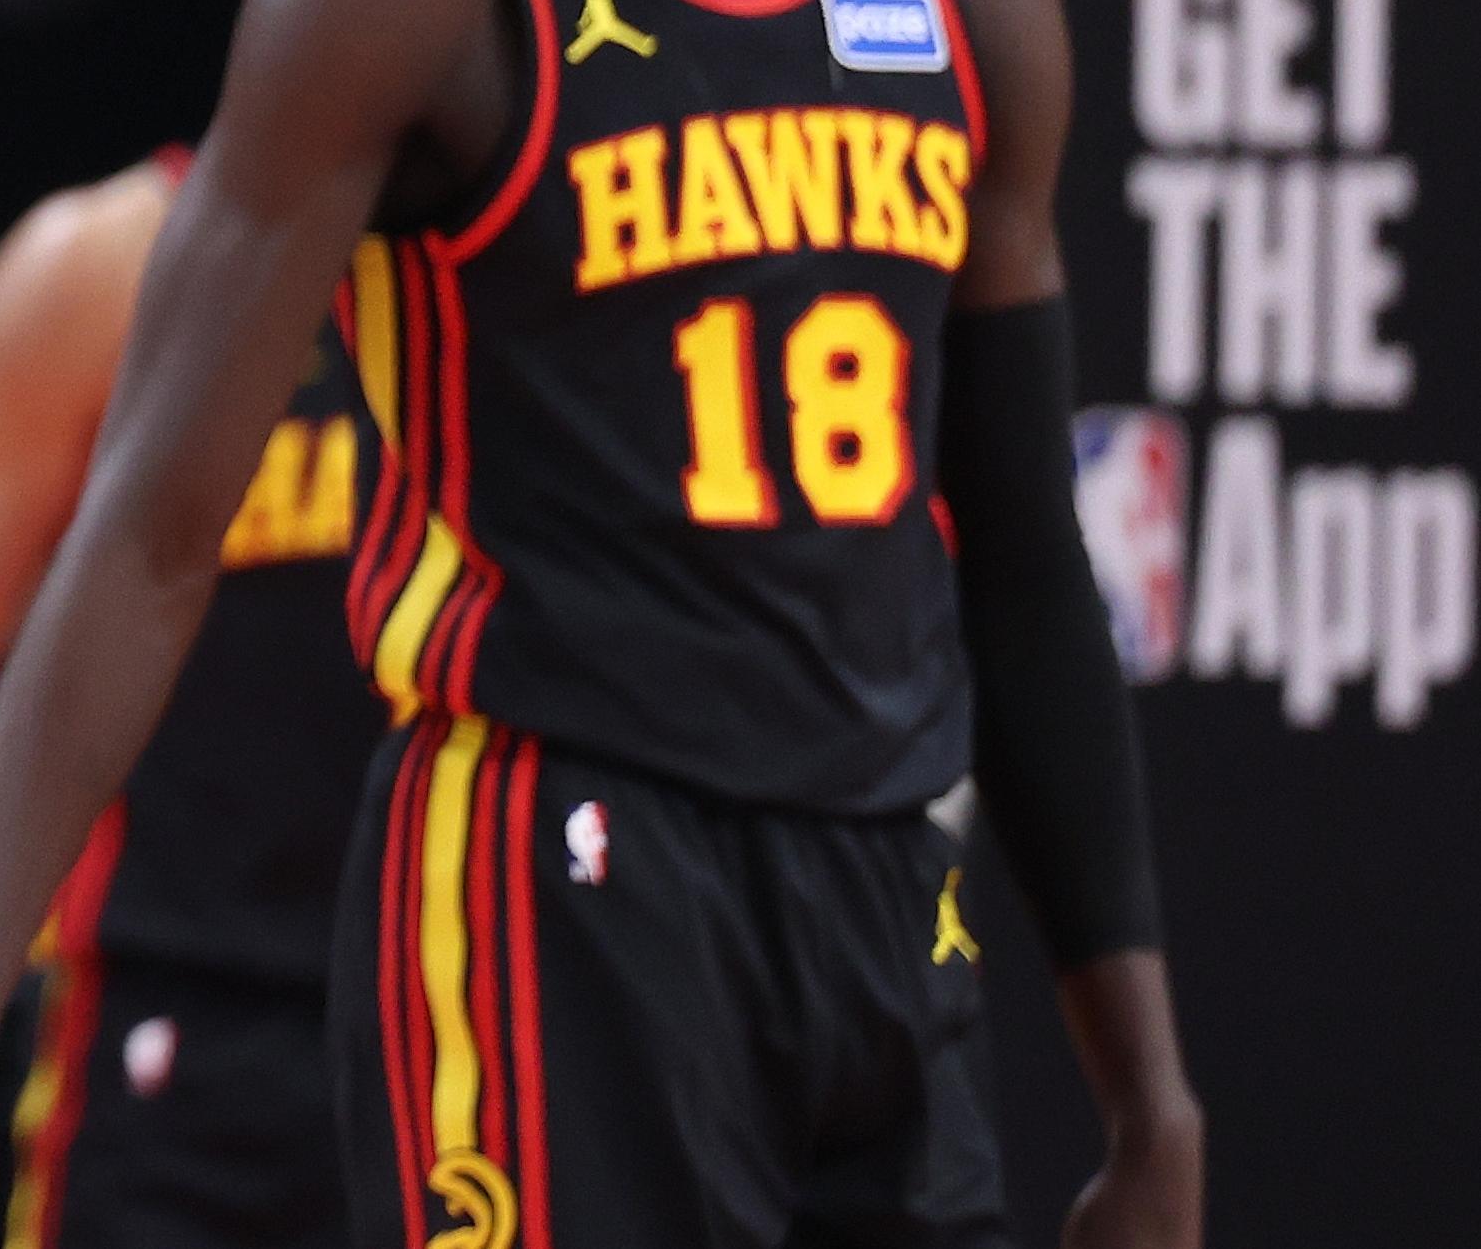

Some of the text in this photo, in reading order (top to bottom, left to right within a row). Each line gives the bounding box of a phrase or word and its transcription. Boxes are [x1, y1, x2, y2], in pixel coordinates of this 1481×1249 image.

[567, 104, 973, 295] HAWKS
[1124, 157, 1419, 407] THE
[671, 291, 917, 529] 18
[1189, 413, 1477, 731] App
